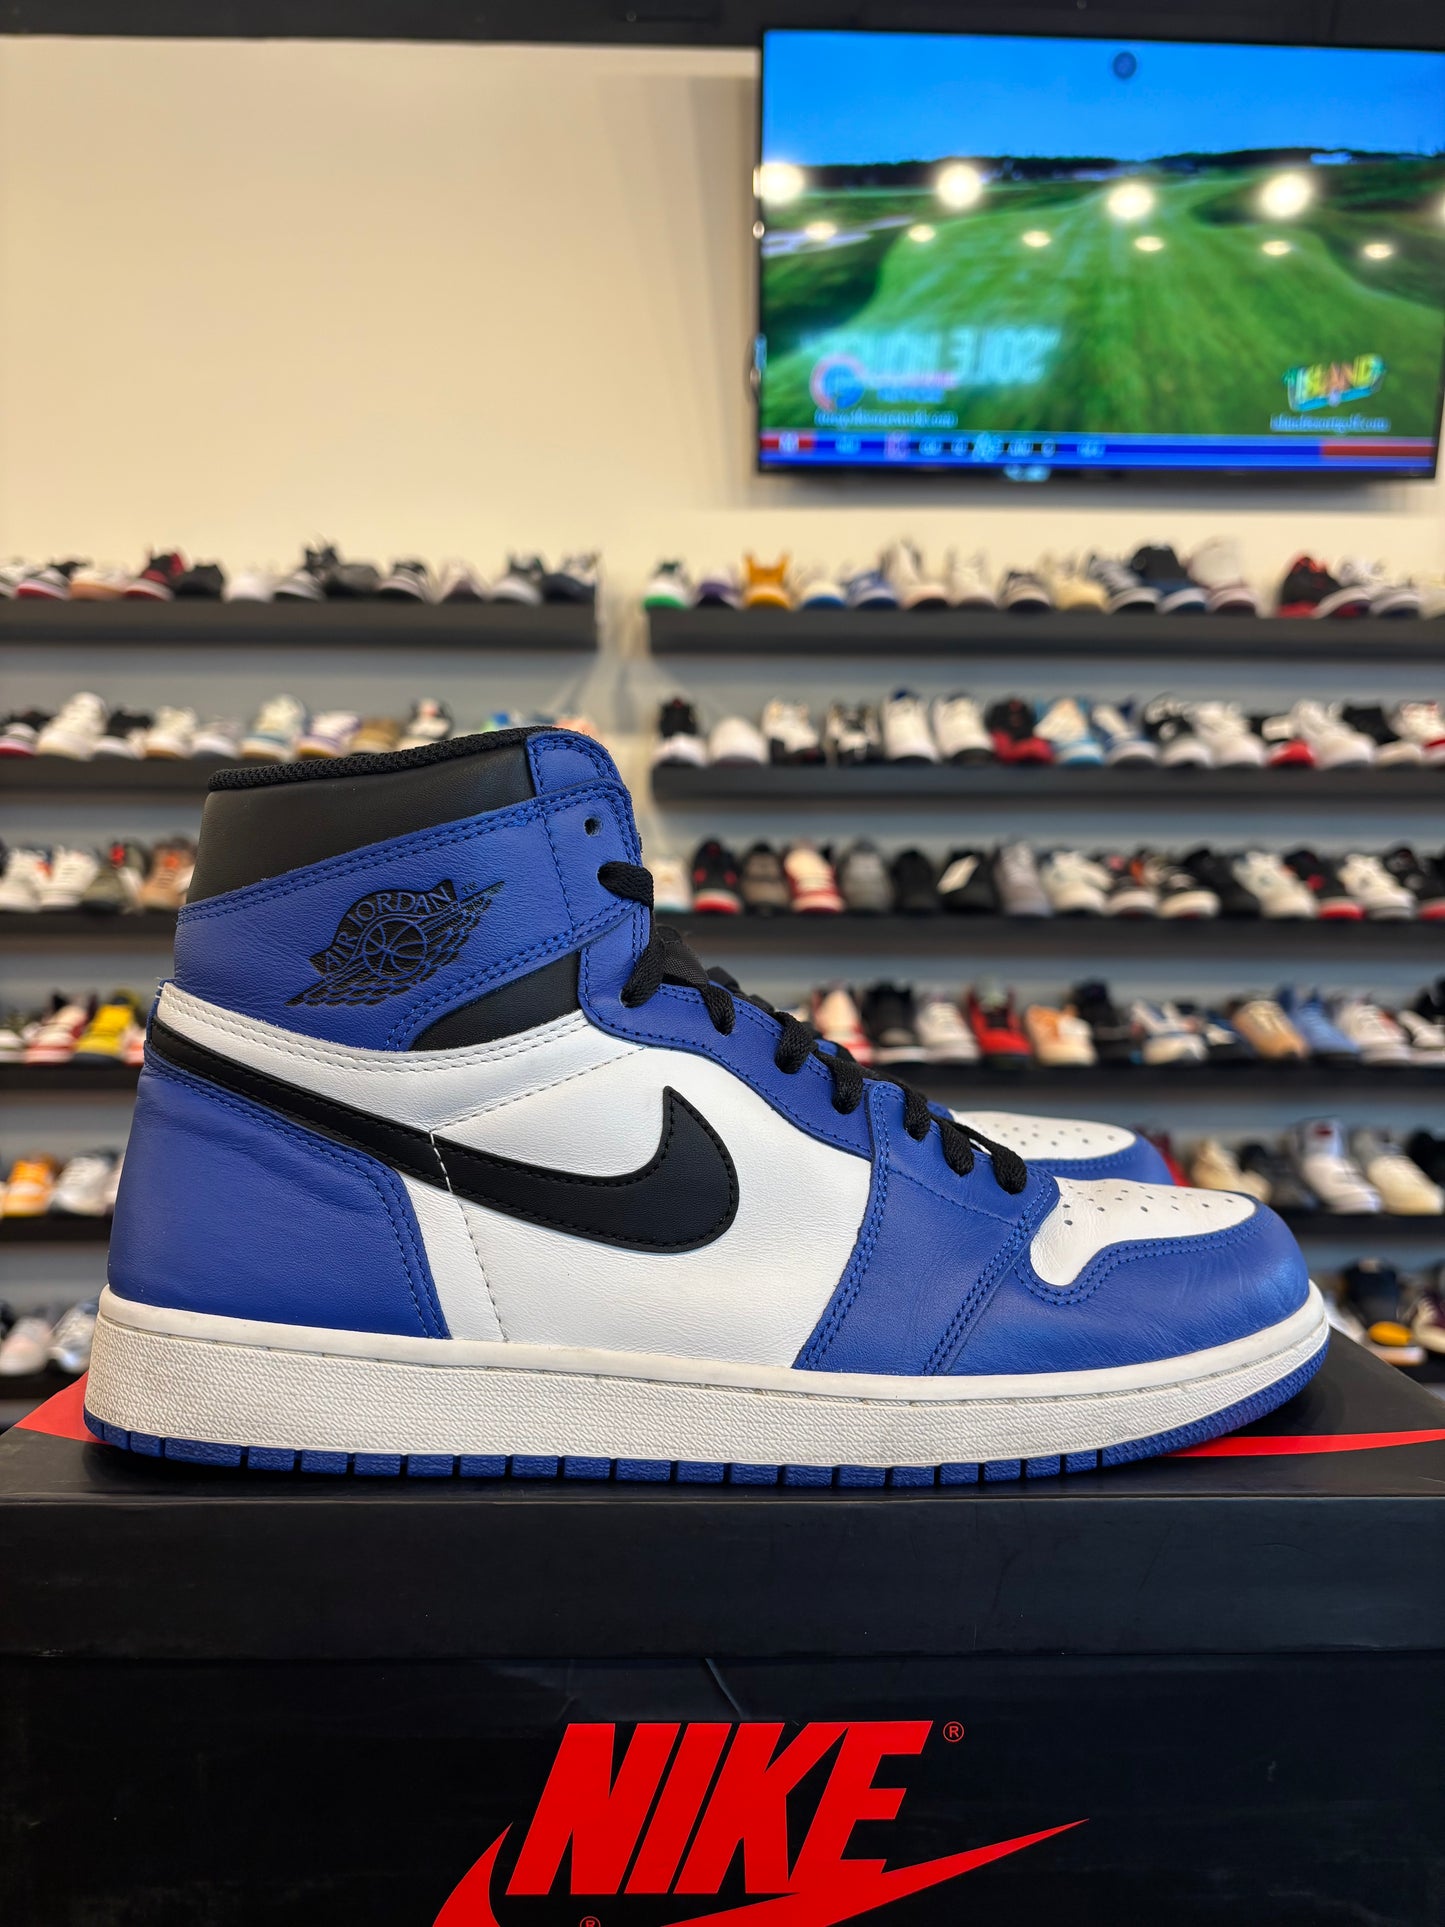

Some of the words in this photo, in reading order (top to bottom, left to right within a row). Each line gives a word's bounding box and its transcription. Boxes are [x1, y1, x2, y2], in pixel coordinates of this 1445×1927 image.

[323, 931, 360, 973] AIR
[347, 885, 452, 929] JORDAN
[505, 1720, 934, 1895] NIKE
